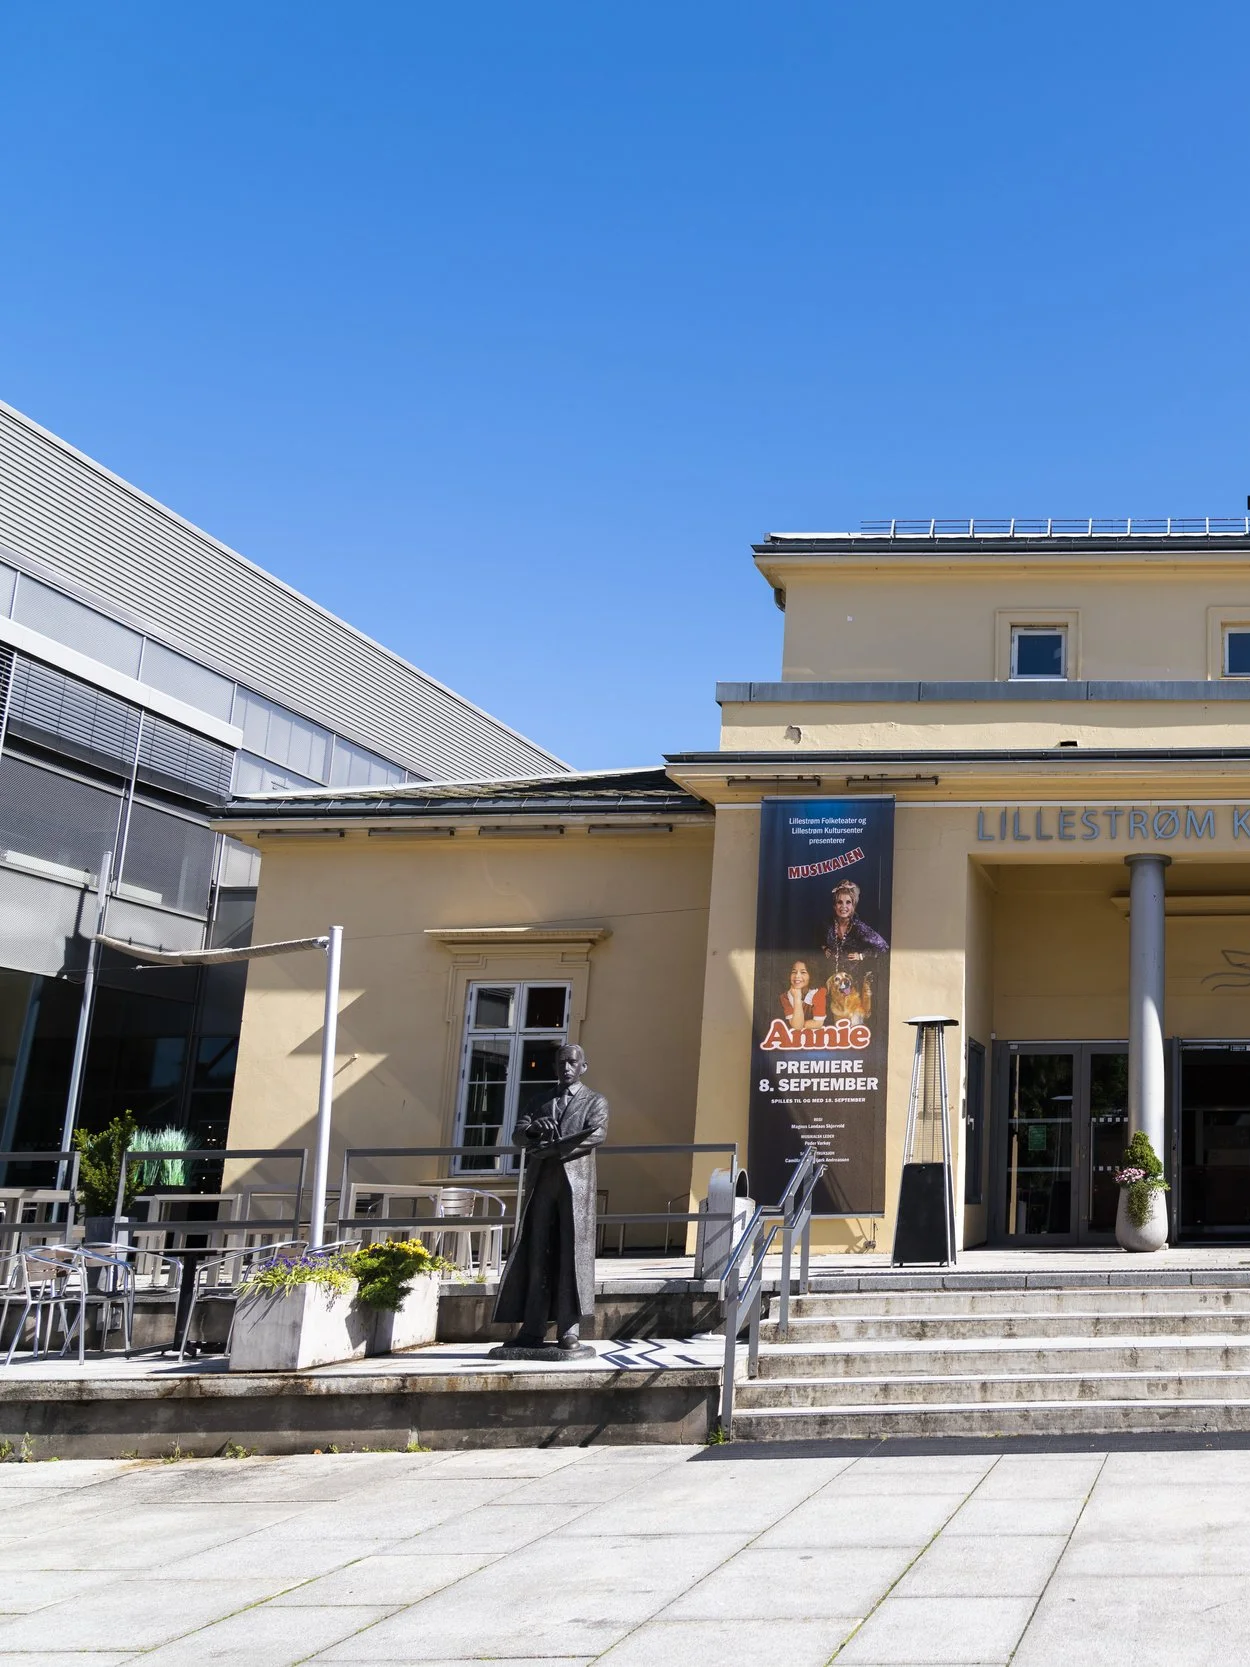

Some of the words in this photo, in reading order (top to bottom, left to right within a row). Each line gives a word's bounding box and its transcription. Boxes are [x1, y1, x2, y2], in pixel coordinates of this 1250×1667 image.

[789, 817, 820, 825] Lillestrøm
[976, 809, 1215, 841] LILLESTRØM
[788, 847, 865, 879] MUSIKALEN
[760, 1019, 871, 1051] Annie
[776, 1060, 863, 1075] PREMIERE
[759, 1078, 774, 1092] 8.
[778, 1077, 879, 1091] SEPTEMBER
